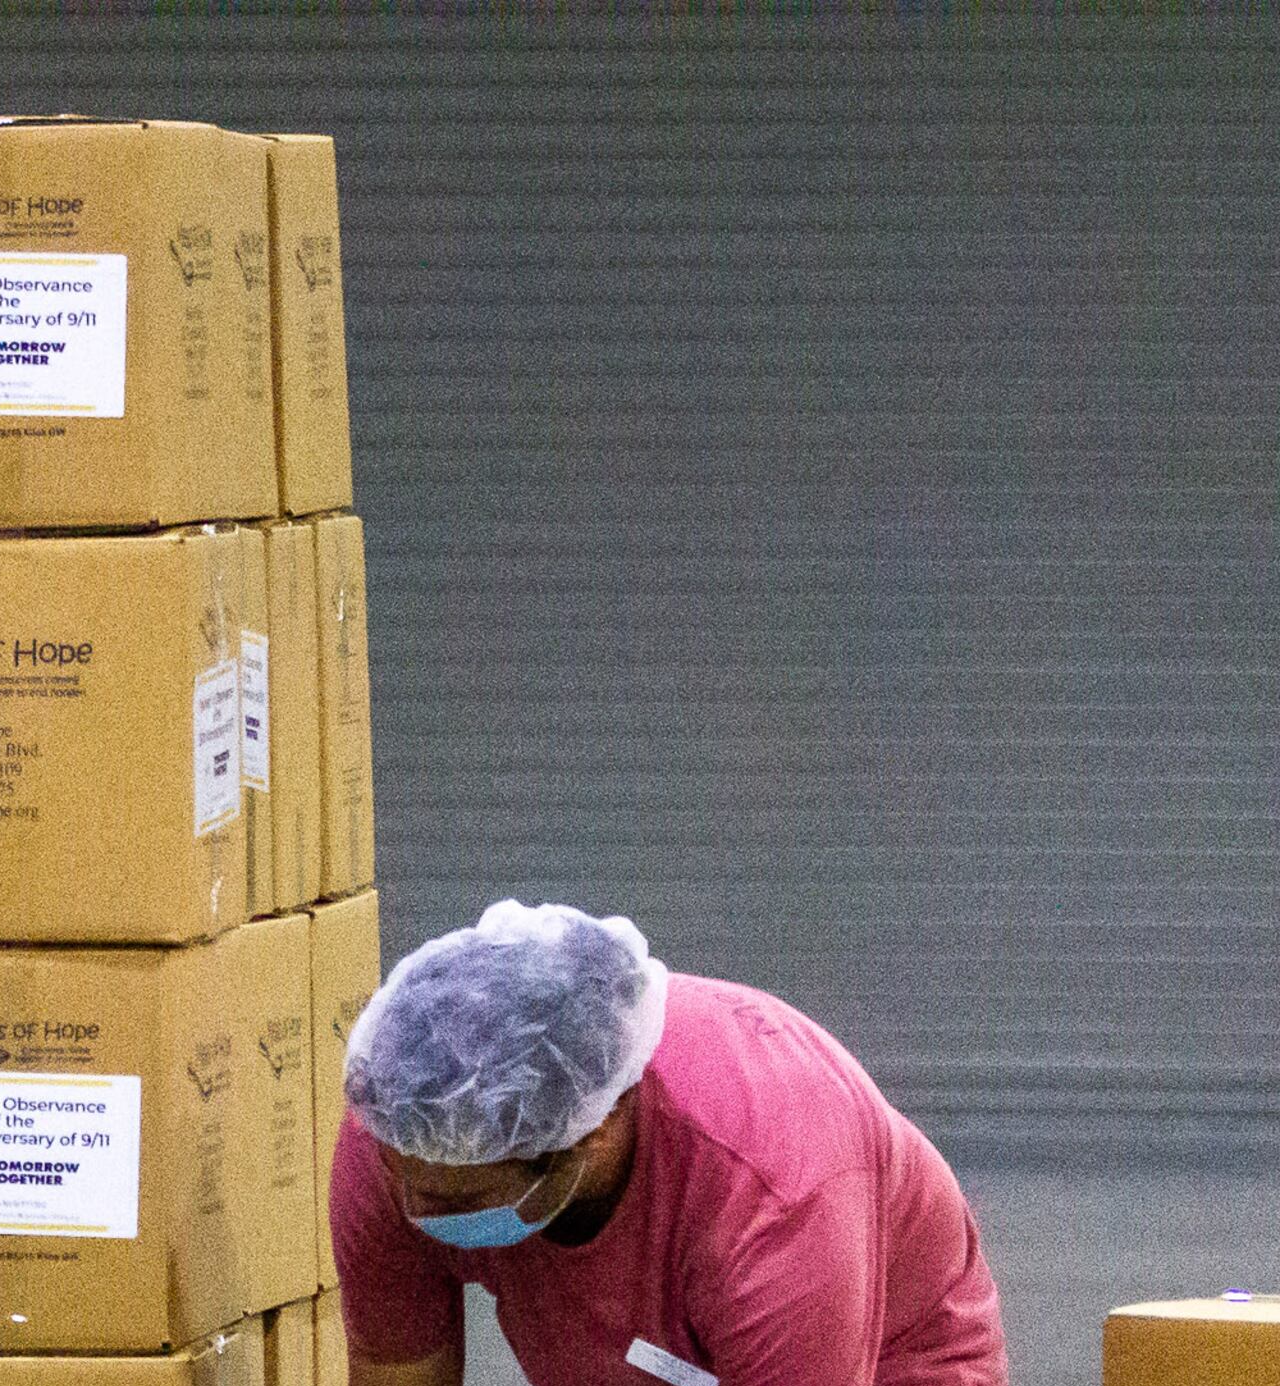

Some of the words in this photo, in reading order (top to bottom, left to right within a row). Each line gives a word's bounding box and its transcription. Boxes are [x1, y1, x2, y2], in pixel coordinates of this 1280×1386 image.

[27, 196, 85, 217] Hope
[44, 311, 64, 327] of
[66, 310, 97, 327] 9/11
[13, 638, 94, 668] Hope
[11, 1020, 39, 1041] of
[43, 1021, 101, 1043] Hope
[2, 1096, 107, 1114] Observance
[5, 1114, 35, 1128] the
[58, 1131, 78, 1147] of
[80, 1132, 111, 1148] 9/11
